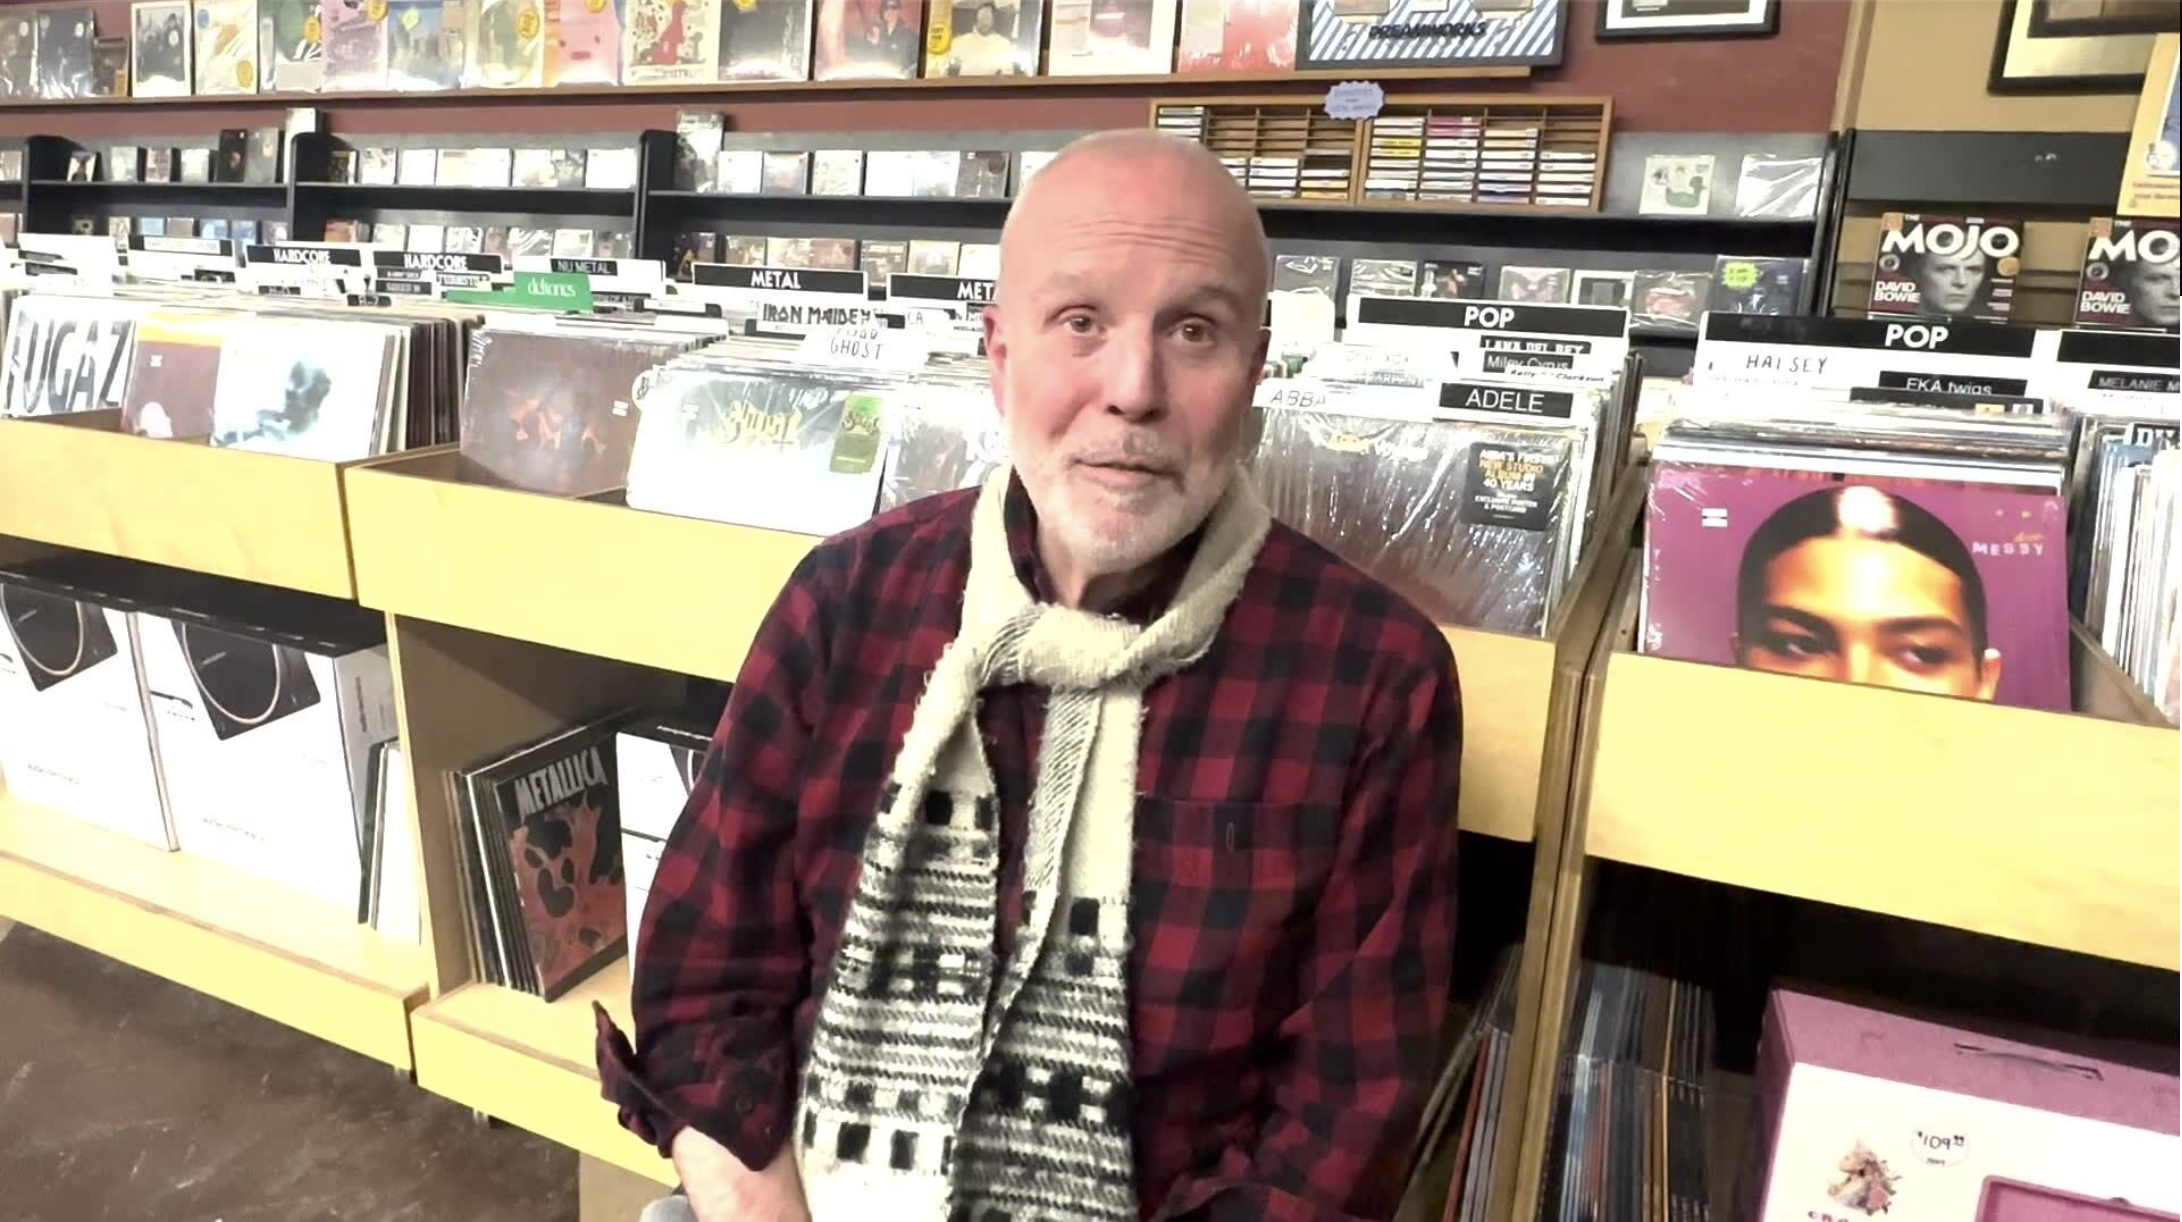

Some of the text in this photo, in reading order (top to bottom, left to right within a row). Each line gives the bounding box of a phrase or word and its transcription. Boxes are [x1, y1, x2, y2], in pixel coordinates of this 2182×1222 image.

[1881, 223, 2019, 259] MOJO
[2088, 229, 2180, 263] MO
[274, 248, 331, 264] HARDCORE
[404, 254, 467, 271] HARDCORE
[576, 262, 611, 274] METAL
[751, 270, 801, 289] METAL
[1875, 281, 1915, 293] DAVID
[1873, 290, 1920, 303] BOWIE
[2082, 291, 2126, 303] DAVID
[763, 303, 802, 324] IRON
[2080, 301, 2131, 315] BOWIE
[1464, 305, 1515, 328] POP
[1884, 324, 1949, 349] POP
[830, 338, 882, 360] GHOST
[1906, 378, 1942, 392] FKA
[2099, 377, 2162, 392] MELANIE
[1465, 388, 1545, 413] ADELE
[1506, 462, 1544, 473] STUDIO
[1500, 479, 1534, 492] YEARS
[1972, 541, 2044, 556] MESSY
[514, 746, 608, 821] METALLICA
